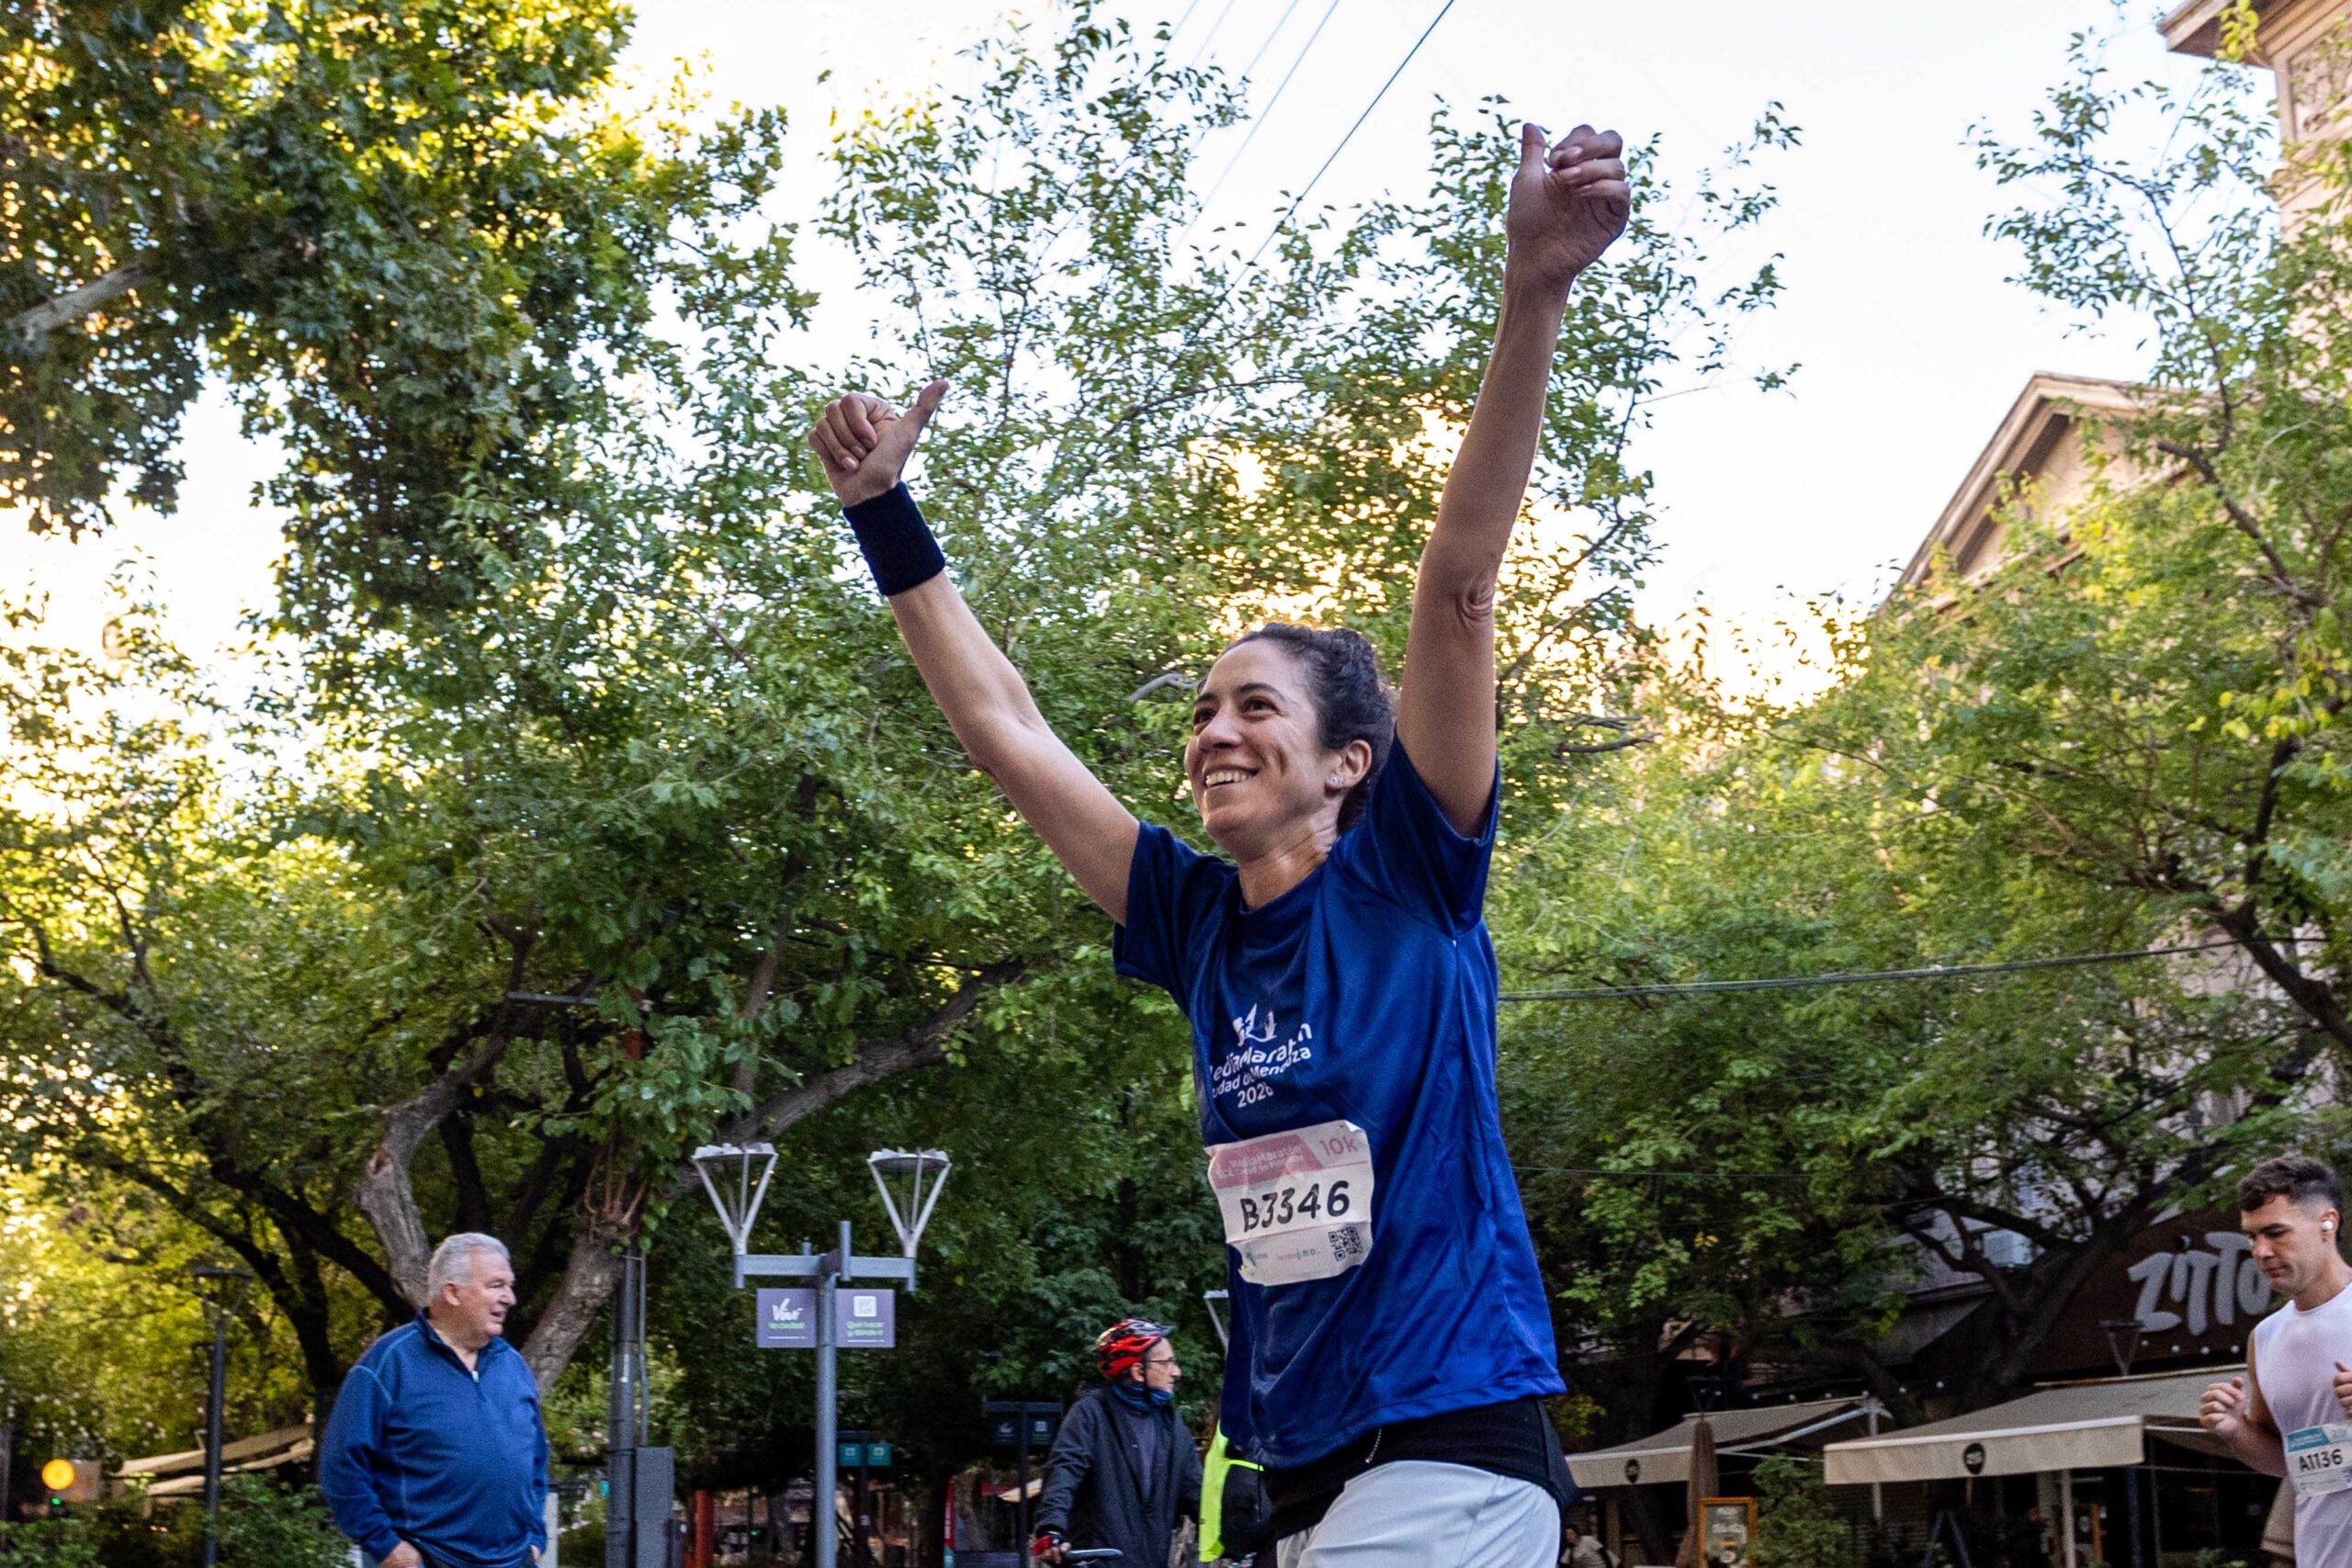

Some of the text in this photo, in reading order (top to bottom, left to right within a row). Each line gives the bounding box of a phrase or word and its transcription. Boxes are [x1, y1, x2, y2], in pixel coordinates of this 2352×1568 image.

[1238, 1082, 1273, 1108] 2026
[1240, 1179, 1351, 1232] B3346
[2299, 1449, 2343, 1472] A1136
